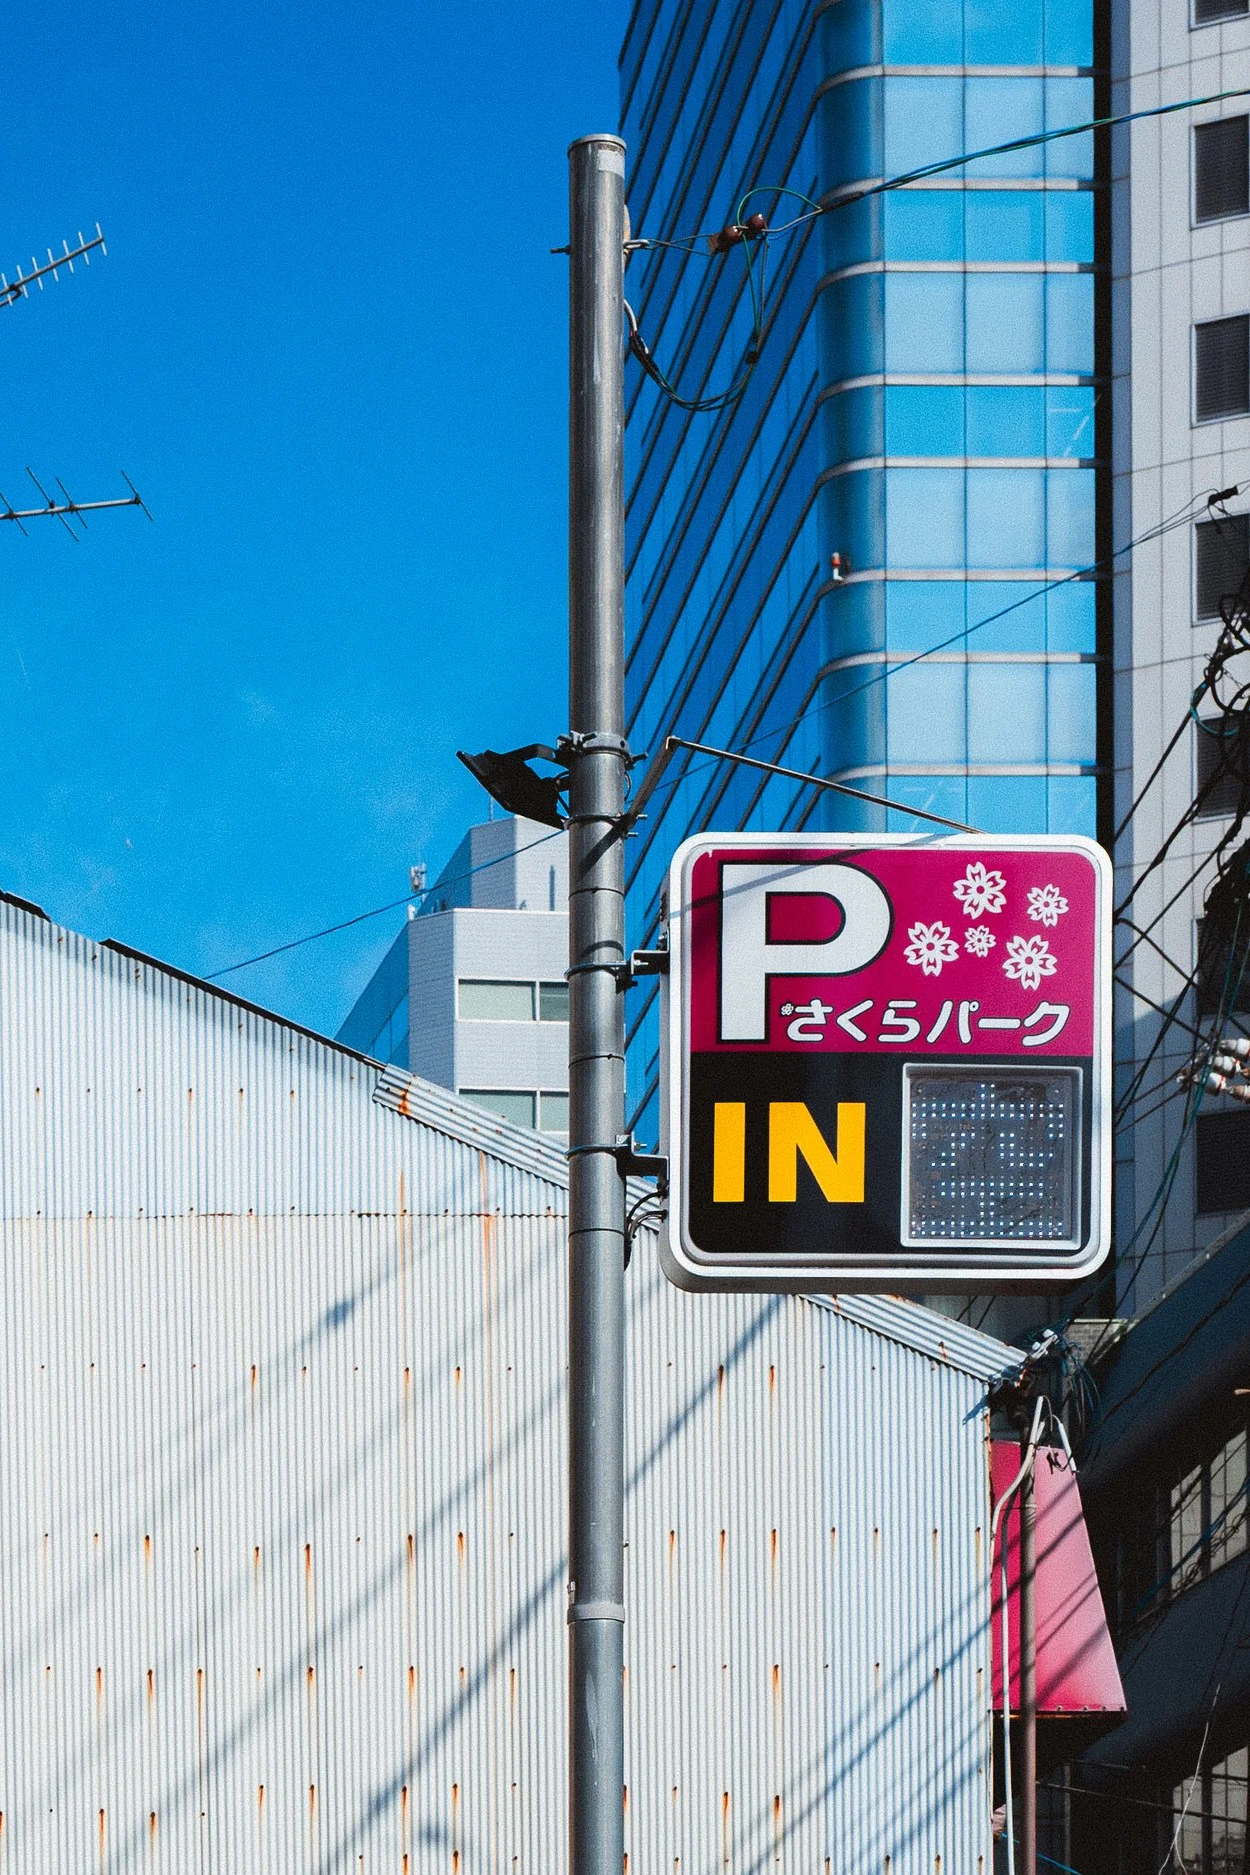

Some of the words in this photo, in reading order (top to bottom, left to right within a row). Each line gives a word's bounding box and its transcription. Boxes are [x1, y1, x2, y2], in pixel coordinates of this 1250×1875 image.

[718, 859, 894, 1044] P
[786, 998, 1070, 1047] さくらパーク
[713, 1101, 867, 1203] IN
